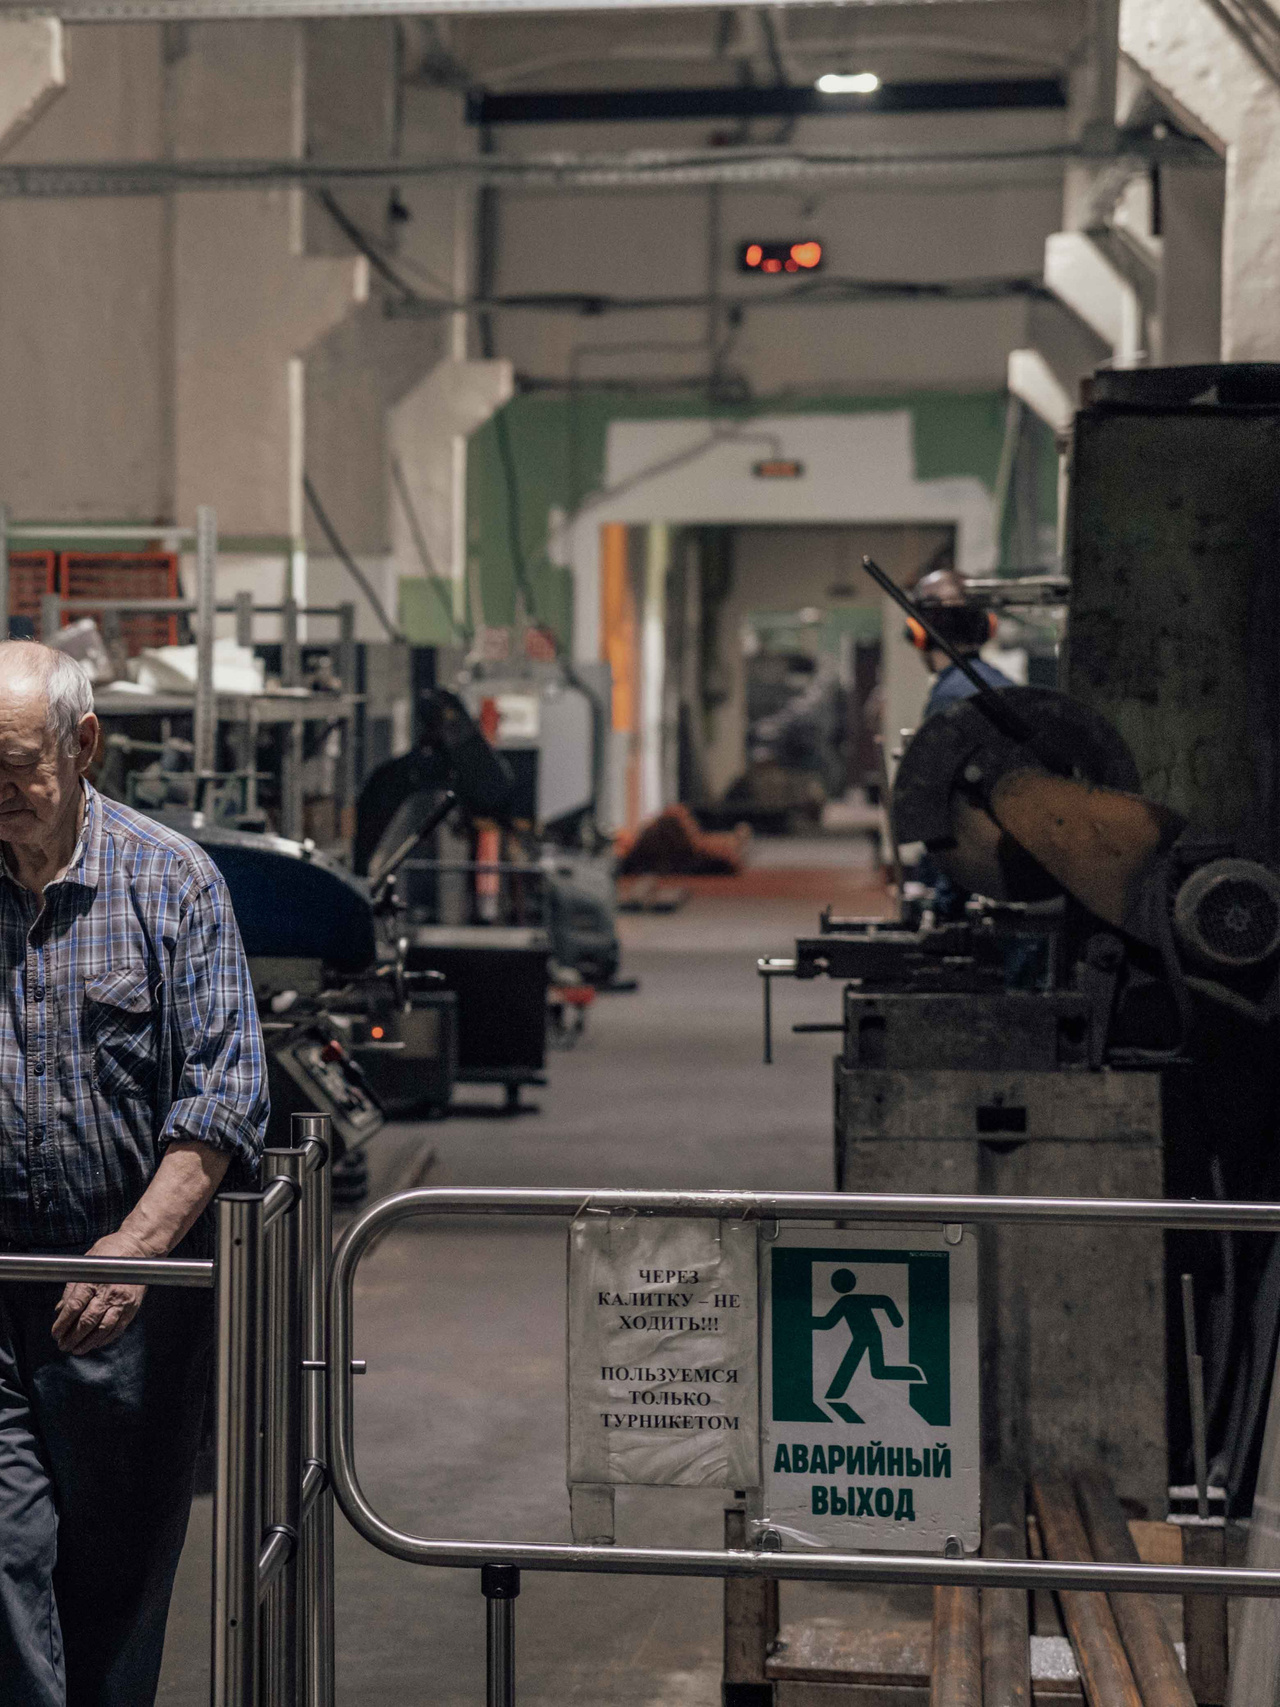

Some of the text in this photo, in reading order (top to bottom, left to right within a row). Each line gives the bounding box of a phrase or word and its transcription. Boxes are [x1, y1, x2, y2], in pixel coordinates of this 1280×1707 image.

[639, 1269, 699, 1285] ЧЕРЕЗ
[598, 1291, 694, 1307] КАЛИТКУ
[714, 1294, 741, 1308] НЕ
[619, 1315, 719, 1332] ХОДИТЬ!!!
[600, 1366, 738, 1384] ПОЛЬЗУЕМСЯ
[628, 1390, 711, 1406] ТОЛЬКО
[600, 1413, 739, 1431] ТУРНИКЕТОМ
[773, 1440, 952, 1478] АВАРИЙНЫЙ
[811, 1485, 916, 1522] ВЫХОД
